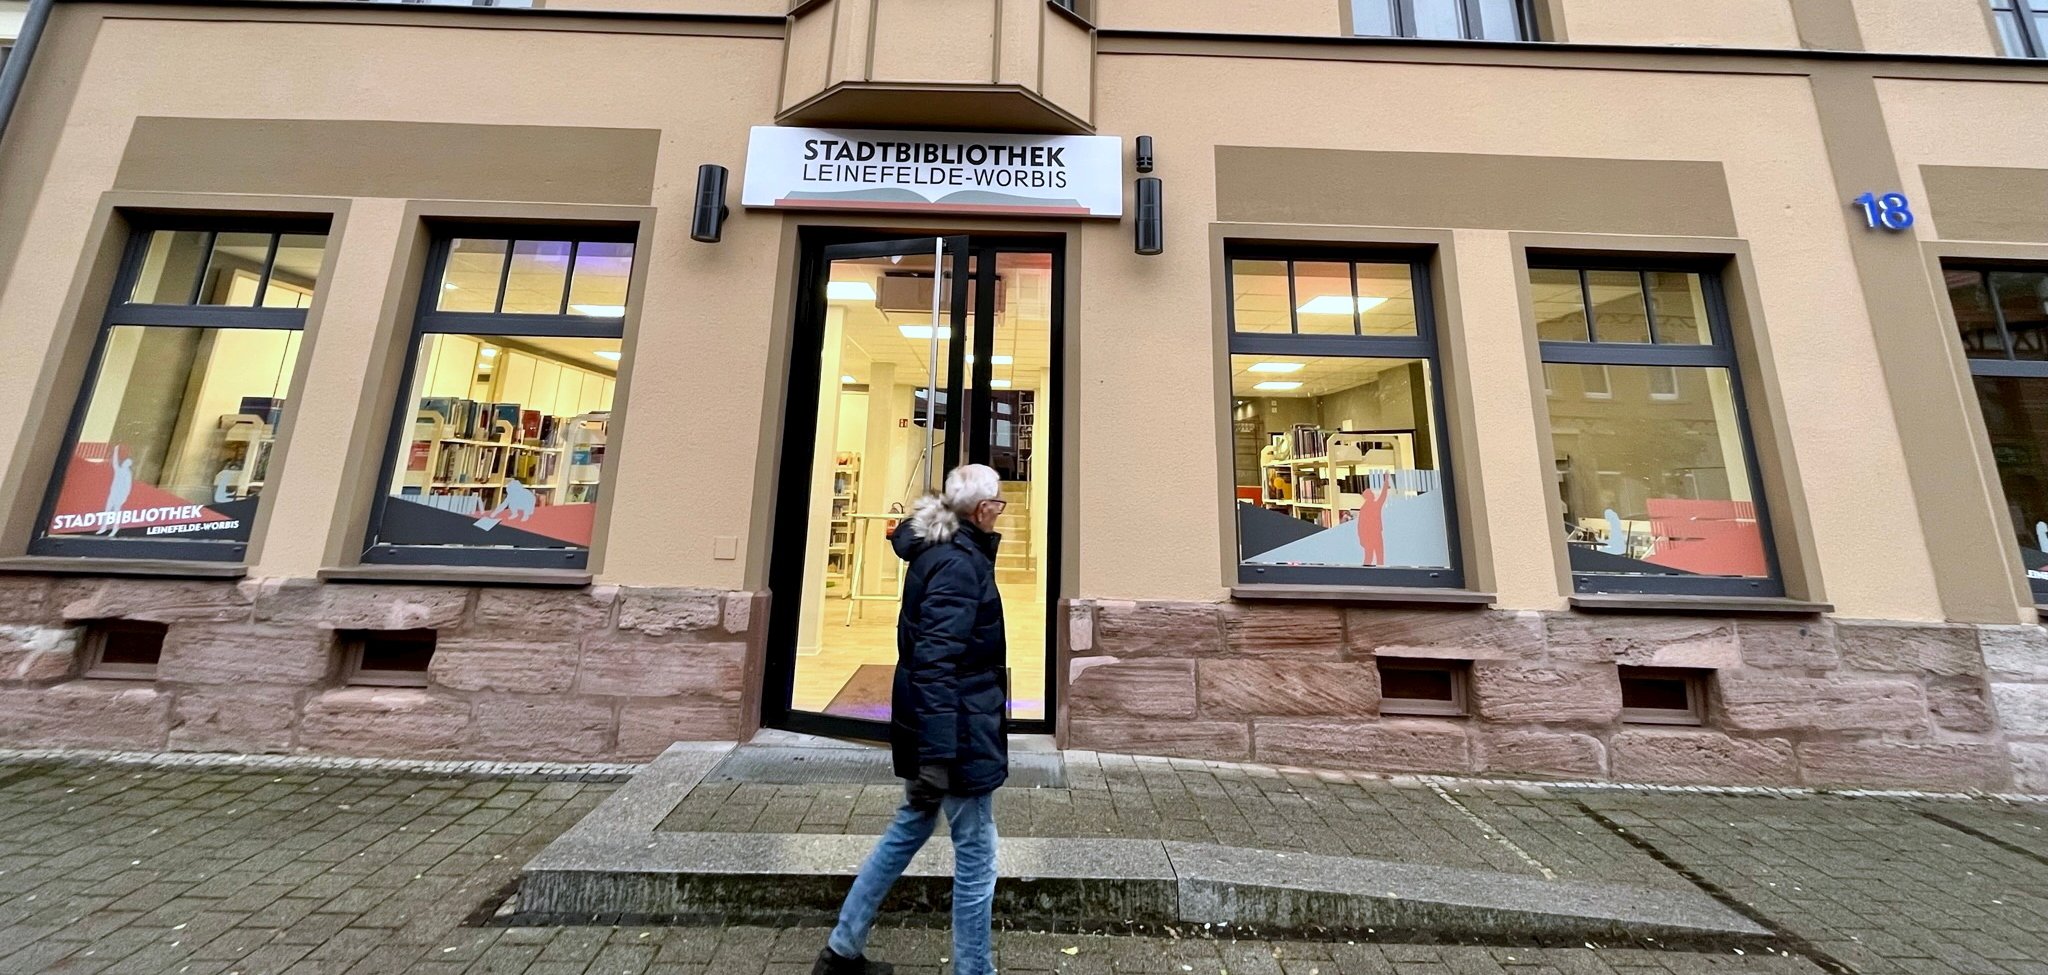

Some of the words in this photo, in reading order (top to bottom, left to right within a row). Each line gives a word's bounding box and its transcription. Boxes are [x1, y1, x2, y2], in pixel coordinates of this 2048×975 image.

[804, 139, 1066, 167] STADTBIBLIOTHEK
[803, 163, 1067, 188] LEINEFELDE-WORBIS
[1854, 192, 1914, 229] 18
[53, 504, 204, 530] STADTBIBLIOTHEK
[146, 520, 240, 535] LEINEFELDE-WORBIS
